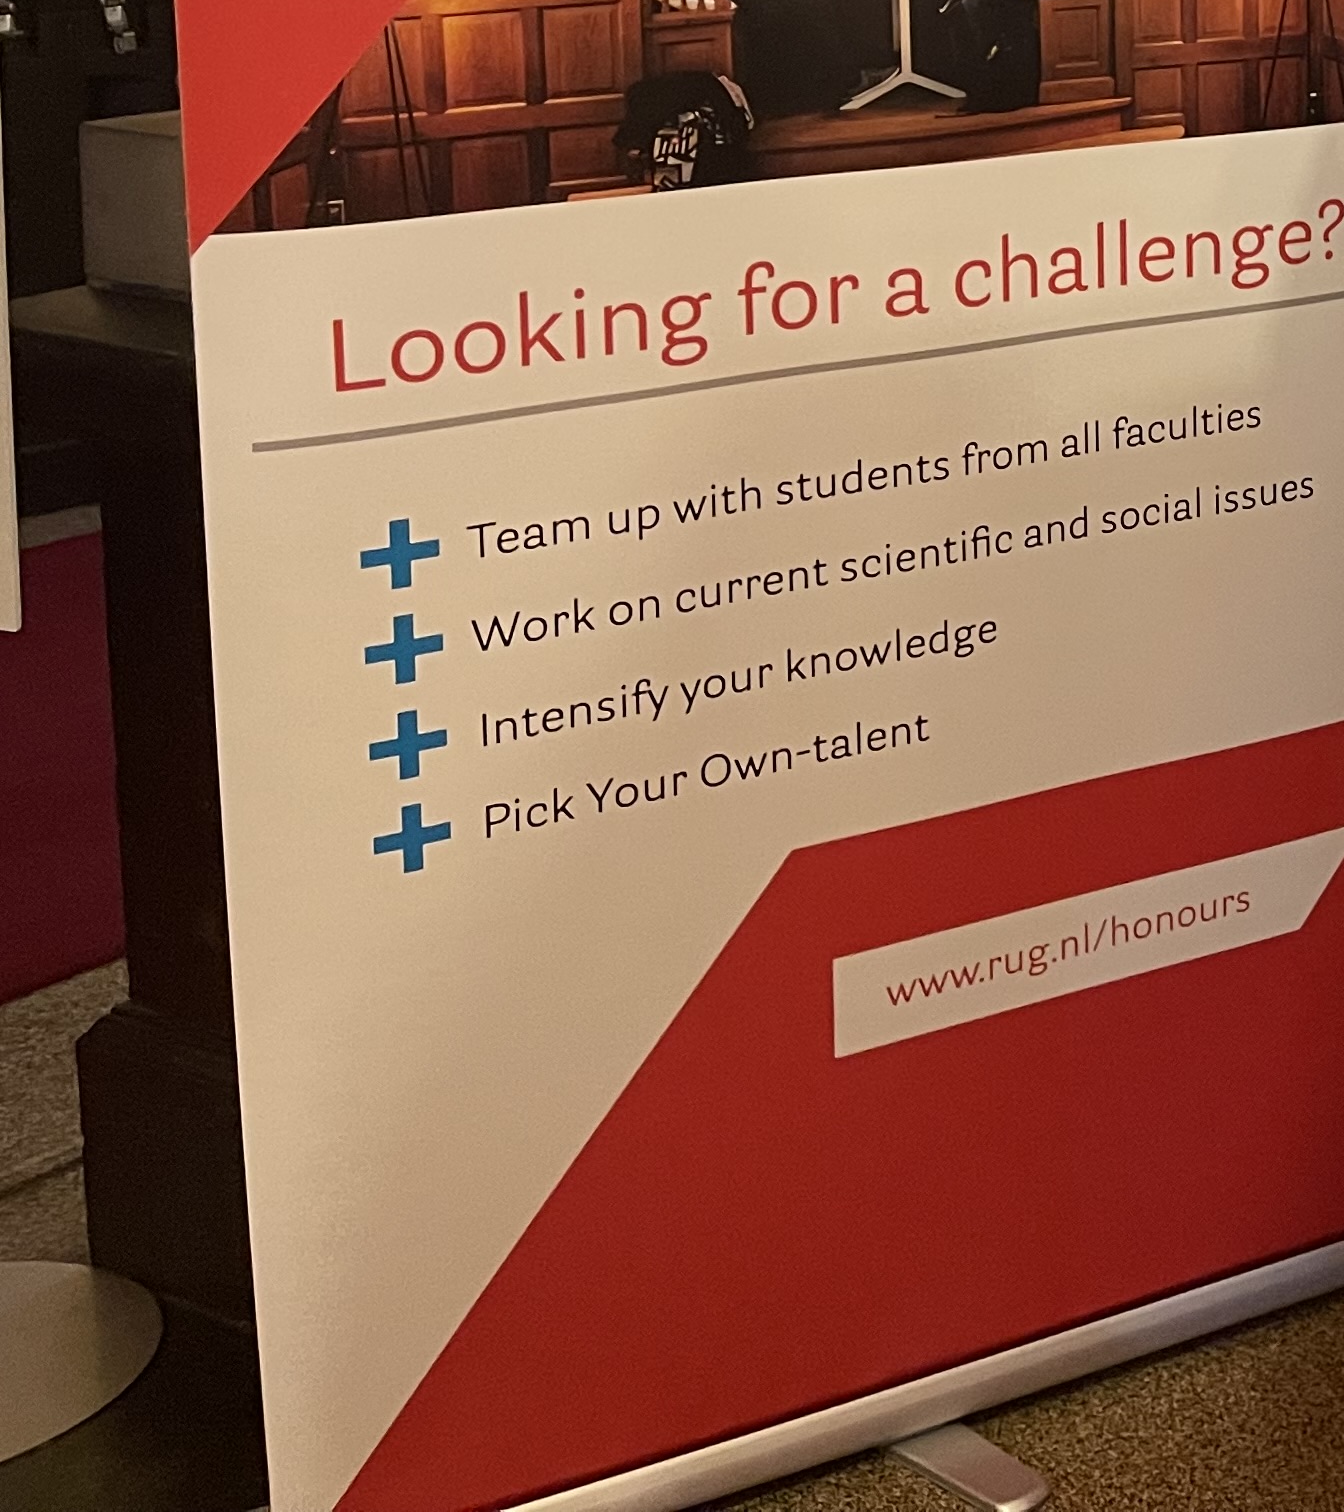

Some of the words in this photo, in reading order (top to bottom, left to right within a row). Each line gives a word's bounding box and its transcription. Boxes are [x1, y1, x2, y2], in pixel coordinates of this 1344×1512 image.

[333, 288, 712, 392] Looking
[737, 261, 859, 335] for
[886, 269, 929, 317] a
[955, 199, 1344, 307] challenge?
[466, 517, 589, 557] Team
[609, 505, 659, 540] up
[674, 478, 761, 523] with
[777, 456, 949, 505] students
[962, 440, 1047, 475] from
[1062, 420, 1099, 457] all
[1113, 404, 1260, 449] faculties
[472, 598, 594, 651] Work
[610, 596, 659, 625] on
[677, 559, 828, 612] current
[841, 525, 1012, 581] scientific
[1025, 506, 1087, 548] and
[1102, 487, 1200, 533] social
[1216, 478, 1313, 514] issues
[482, 679, 668, 746] Intensify
[680, 664, 773, 714] your
[787, 620, 996, 682] knowledge
[486, 788, 574, 838] Pick
[586, 772, 687, 812] Your
[701, 716, 929, 787] Own-talent
[887, 892, 1249, 1006] www.rug.nl/honours
